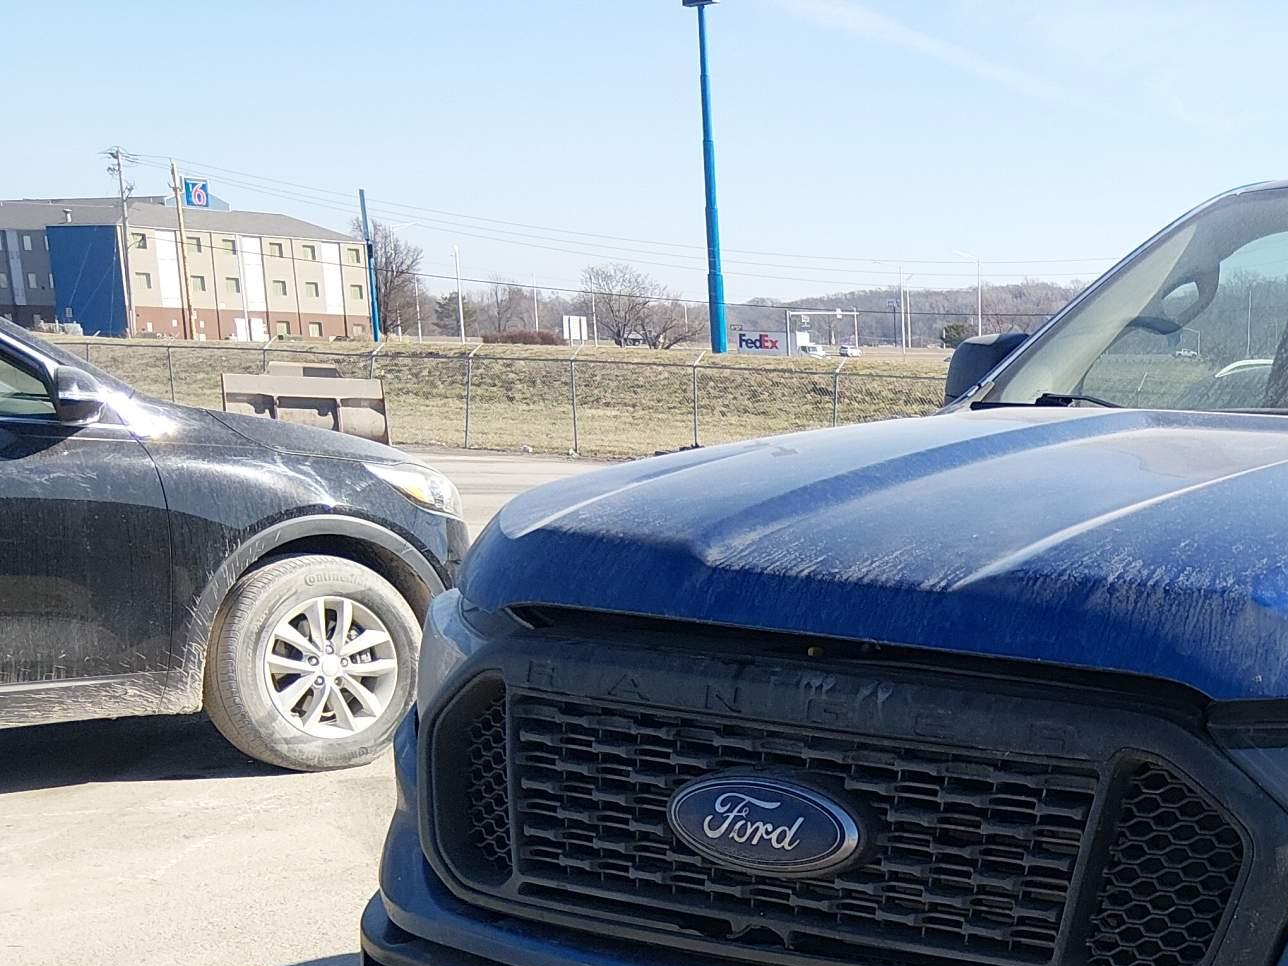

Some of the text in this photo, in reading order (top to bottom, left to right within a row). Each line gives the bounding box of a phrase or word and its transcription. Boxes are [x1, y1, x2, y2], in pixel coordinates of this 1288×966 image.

[191, 183, 207, 206] 6
[738, 331, 779, 350] FedEx
[526, 658, 1078, 753] RANGER
[703, 792, 805, 851] Ford
